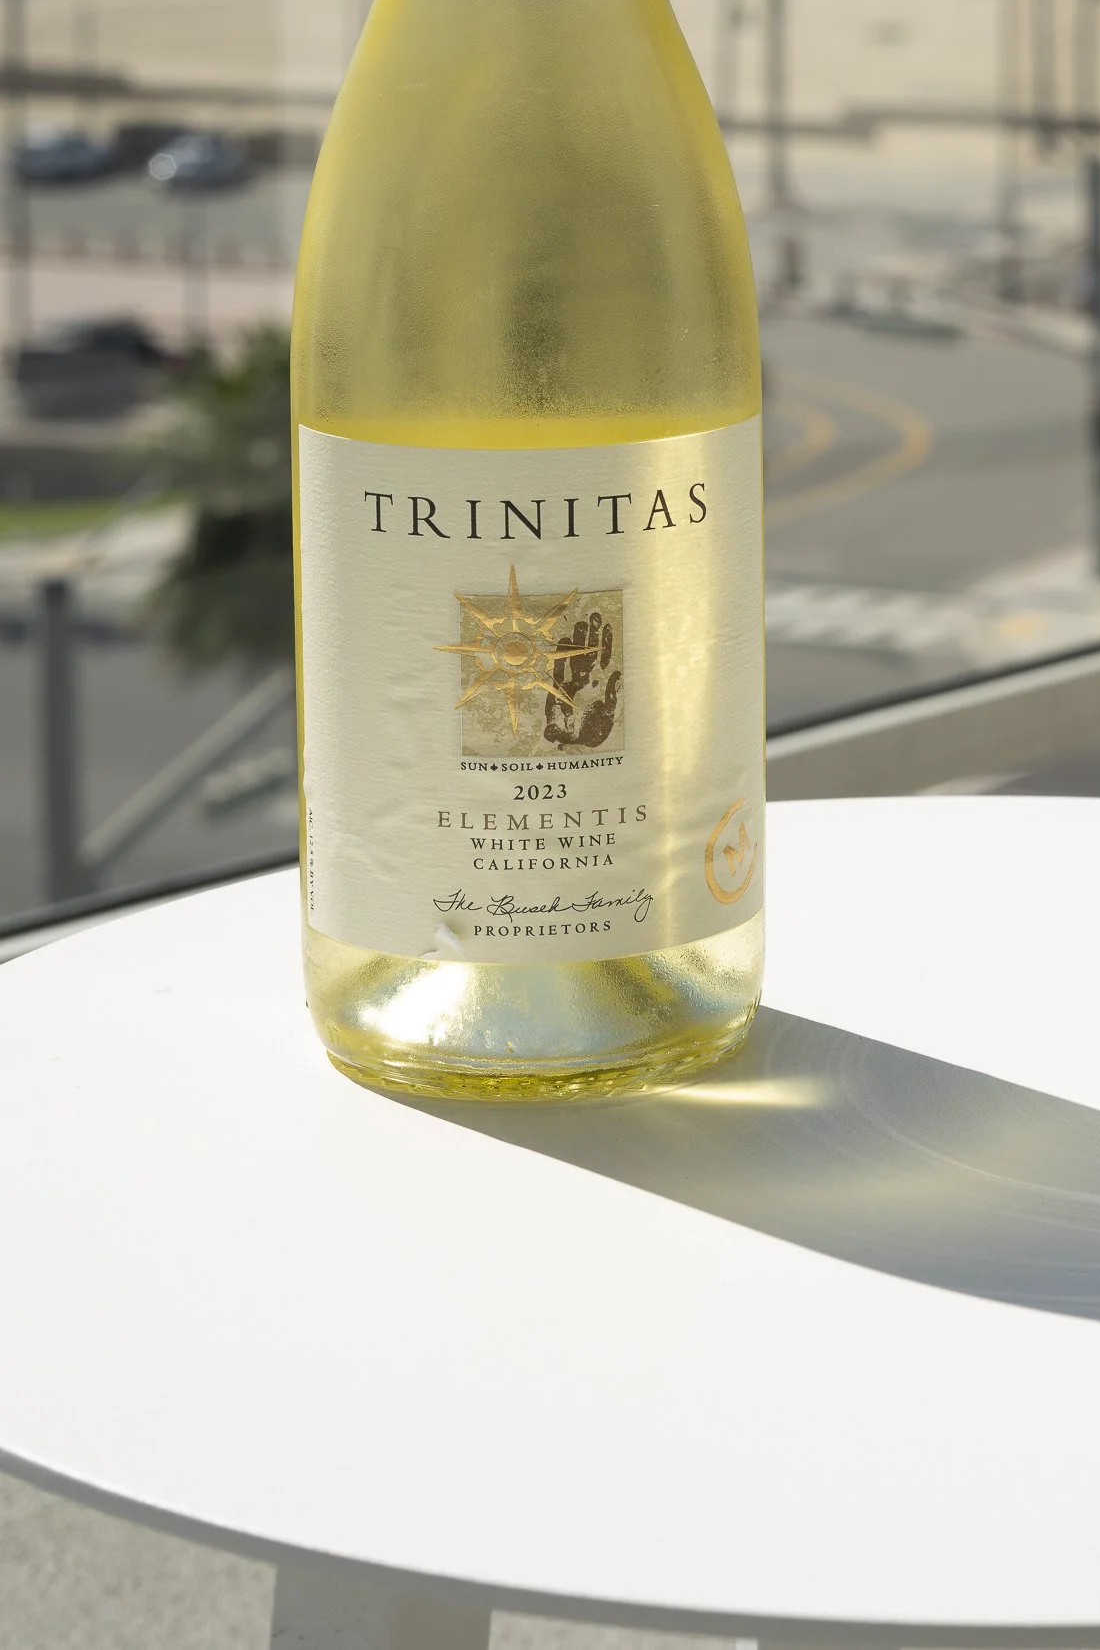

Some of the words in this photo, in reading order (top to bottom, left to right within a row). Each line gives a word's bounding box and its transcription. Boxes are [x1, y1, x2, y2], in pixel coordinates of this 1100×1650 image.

[364, 483, 708, 540] TRINITAS
[460, 761, 488, 772] SUN
[501, 762, 534, 772] SOIL
[547, 756, 624, 771] HUMANITY
[513, 783, 568, 801] 2023
[437, 804, 648, 831] ELEMENTIS
[470, 837, 546, 851] WHITE
[557, 832, 616, 849] WINE
[473, 854, 614, 871] CALIFORNIA
[432, 888, 482, 912] The
[571, 888, 654, 923] Family
[473, 920, 612, 937] PROPRIETORS
